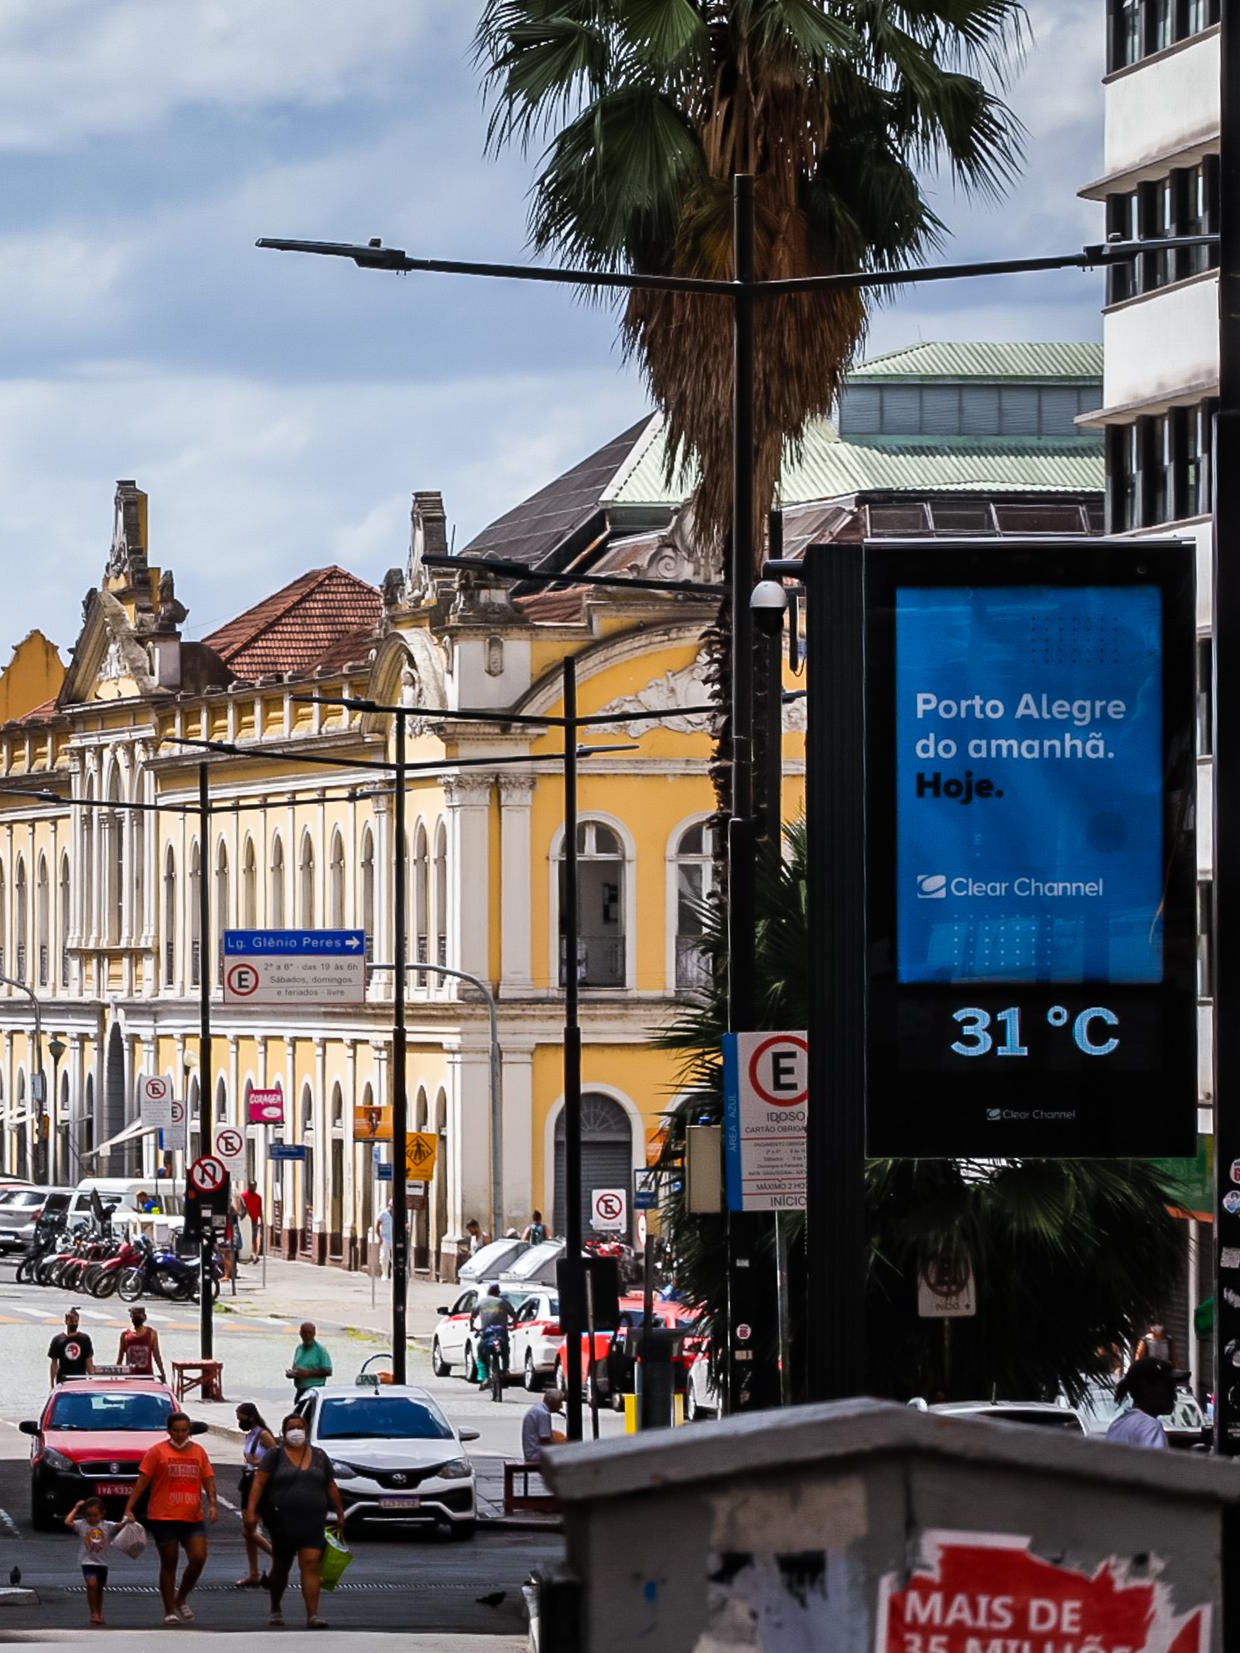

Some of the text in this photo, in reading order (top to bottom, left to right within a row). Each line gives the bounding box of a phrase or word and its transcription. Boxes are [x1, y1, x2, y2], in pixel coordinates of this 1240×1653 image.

[916, 693, 1127, 726] Porto Alegre
[915, 733, 1115, 759] do amanhã.
[916, 770, 1004, 805] Hoje.
[950, 878, 1104, 897] Clear Channel
[227, 936, 342, 950] Lg. Glênio Peres
[301, 962, 317, 971] das
[321, 962, 331, 971] 19
[334, 961, 344, 971] às
[346, 961, 359, 971] 6h
[237, 970, 250, 989] E
[269, 974, 353, 985] Sábados, domingos
[284, 987, 319, 997] feriados
[326, 988, 345, 997] livre
[950, 1005, 1120, 1056] 31 °C
[771, 1051, 799, 1091] E
[766, 1111, 806, 1123] IDOSO
[1002, 1109, 1076, 1119] Clear Channel
[744, 1125, 776, 1134] CARTÃO
[756, 1182, 786, 1190] MÁXIMO
[905, 1591, 1082, 1634] MAIS DE
